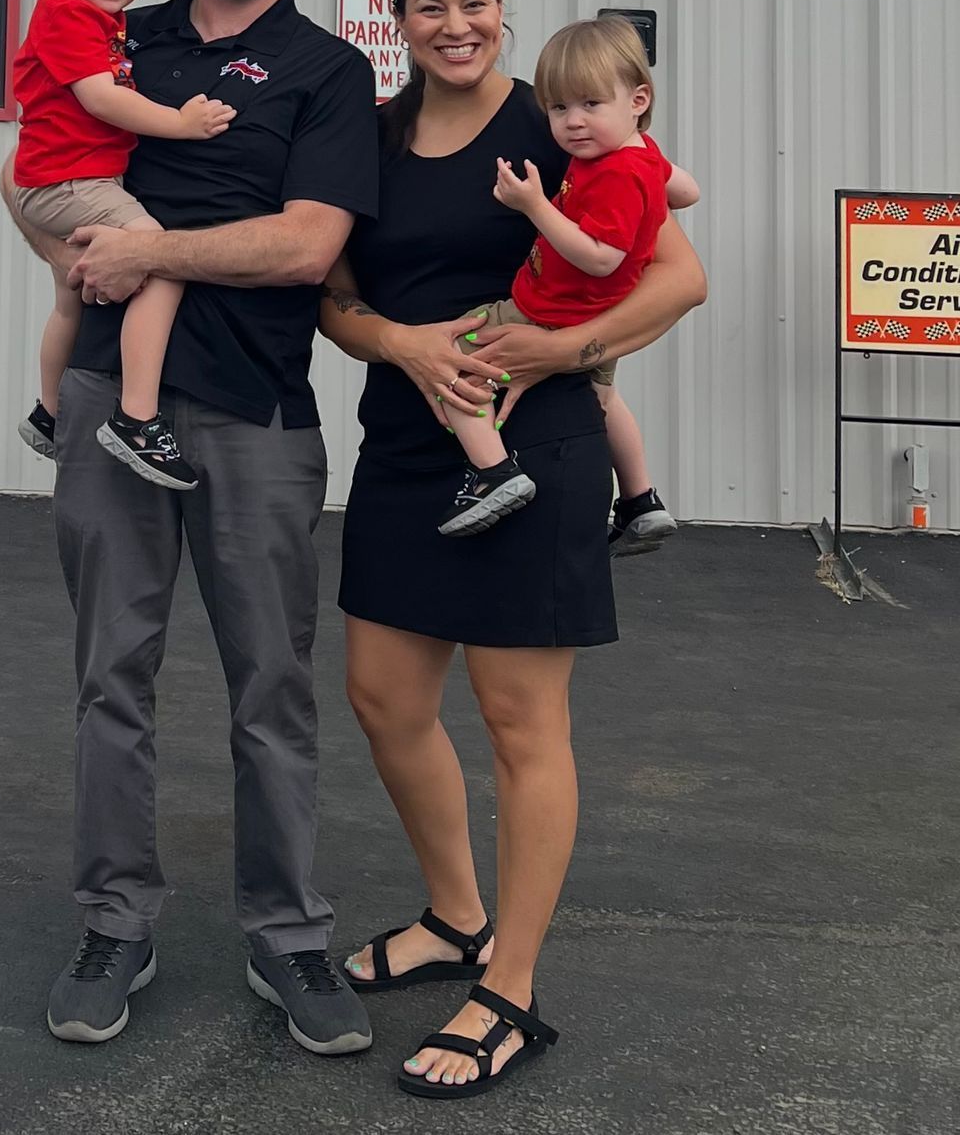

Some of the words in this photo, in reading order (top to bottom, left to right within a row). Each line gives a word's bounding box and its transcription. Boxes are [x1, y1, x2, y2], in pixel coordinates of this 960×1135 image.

[368, 50, 402, 67] ANY
[374, 71, 406, 88] ME
[929, 234, 960, 255] Ai
[862, 260, 960, 284] Condit
